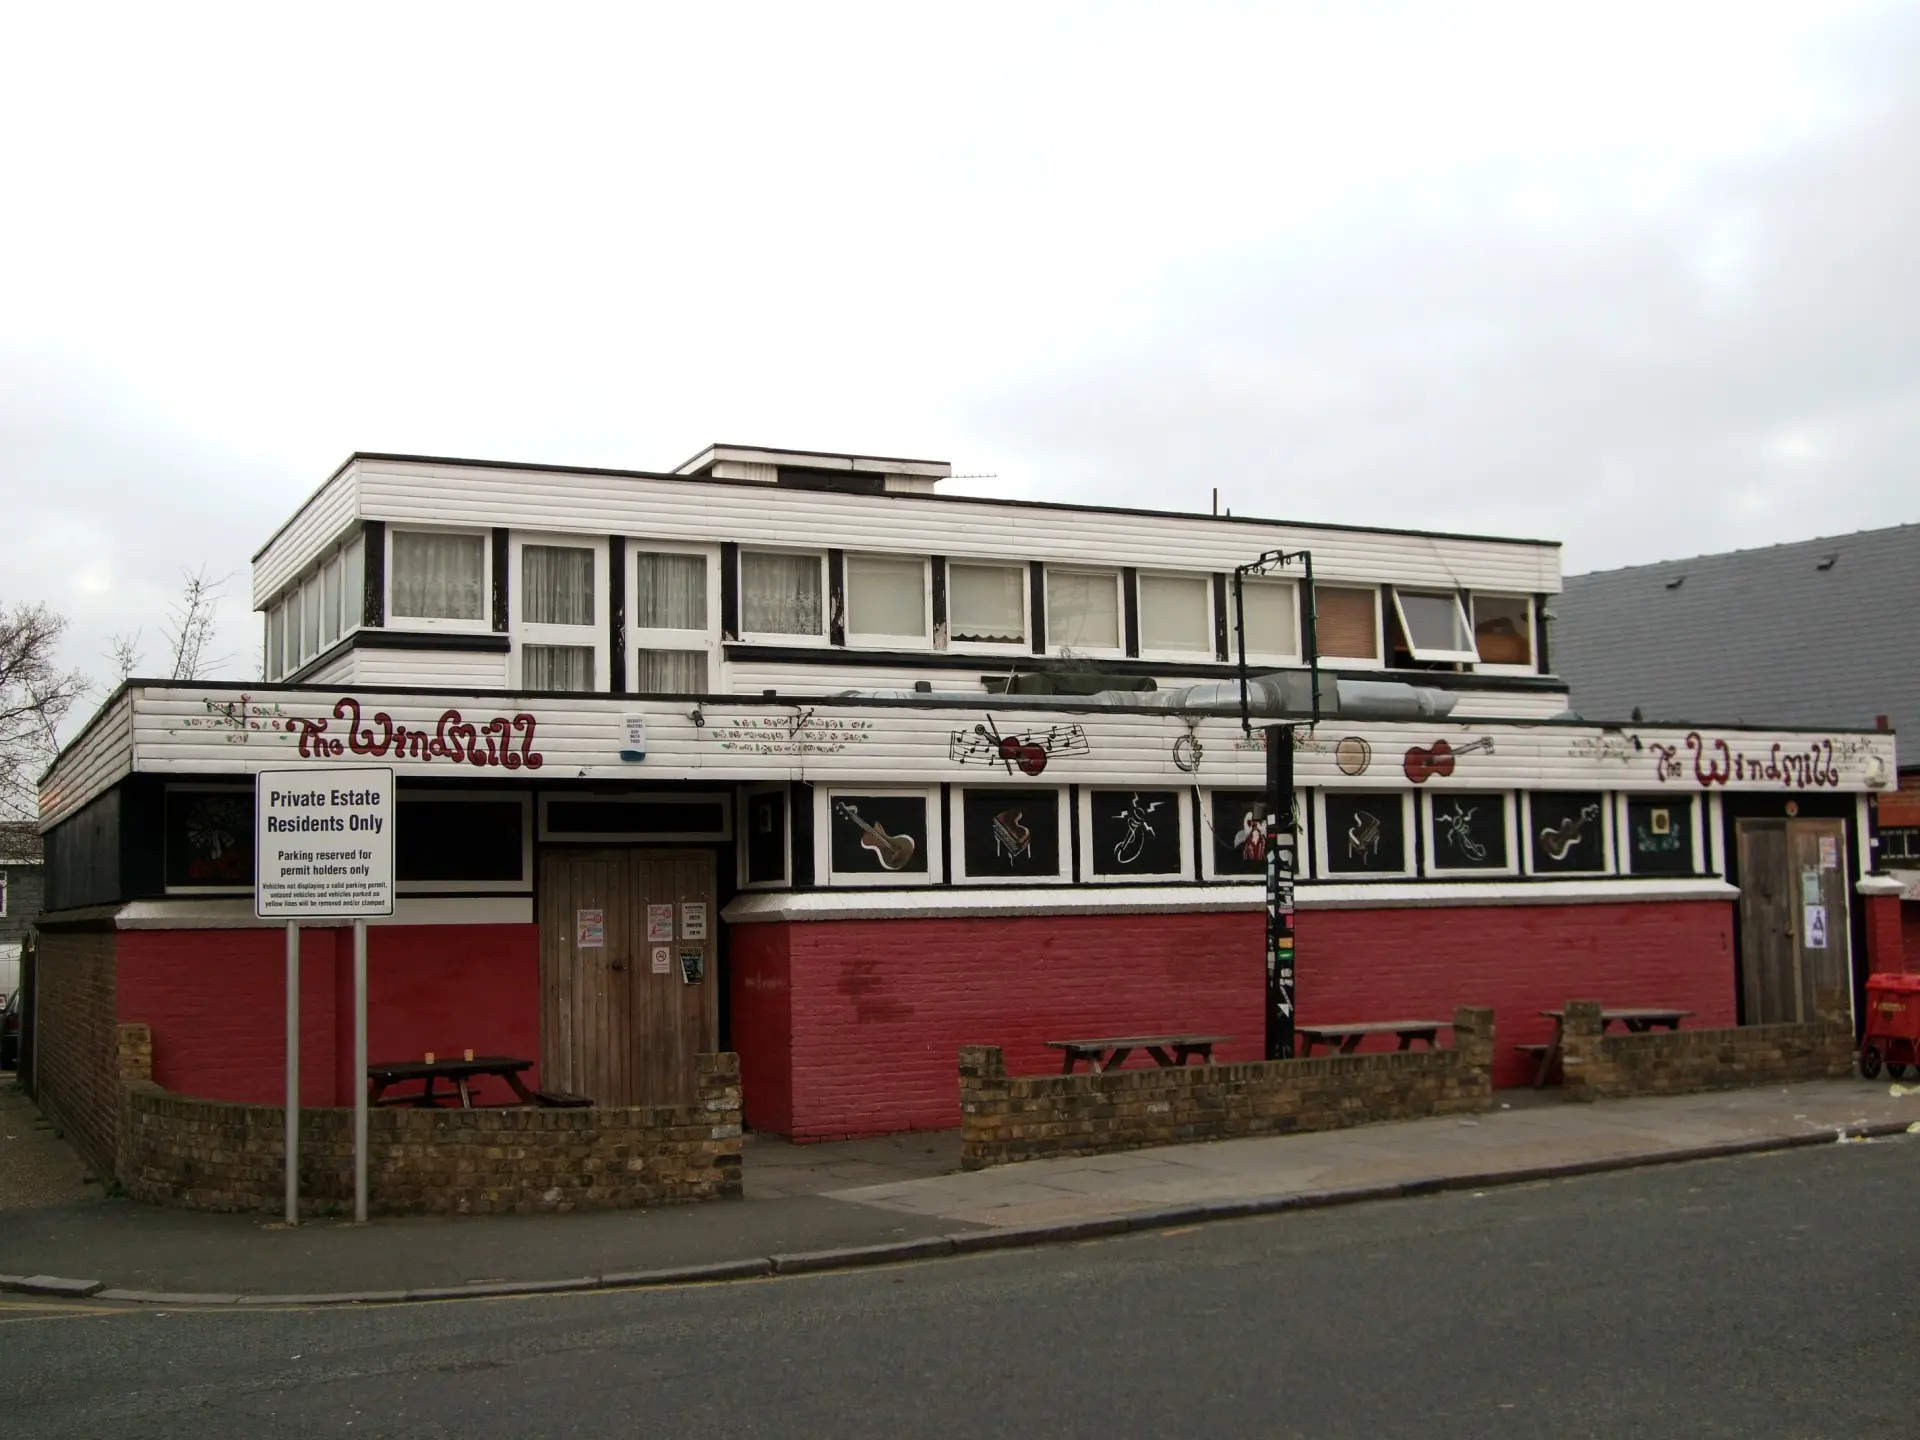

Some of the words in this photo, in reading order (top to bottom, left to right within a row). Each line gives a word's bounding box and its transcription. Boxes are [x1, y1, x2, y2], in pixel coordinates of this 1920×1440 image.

[286, 716, 344, 758] The
[1650, 743, 1682, 782] The
[270, 790, 325, 807] Private
[330, 790, 380, 806] Estate
[268, 816, 344, 832] Residents
[349, 814, 383, 834] Only
[278, 850, 313, 862] Parking
[316, 850, 356, 860] reserved
[359, 850, 372, 860] for
[280, 866, 310, 877] permit
[313, 865, 347, 875] holders
[350, 865, 369, 876] only
